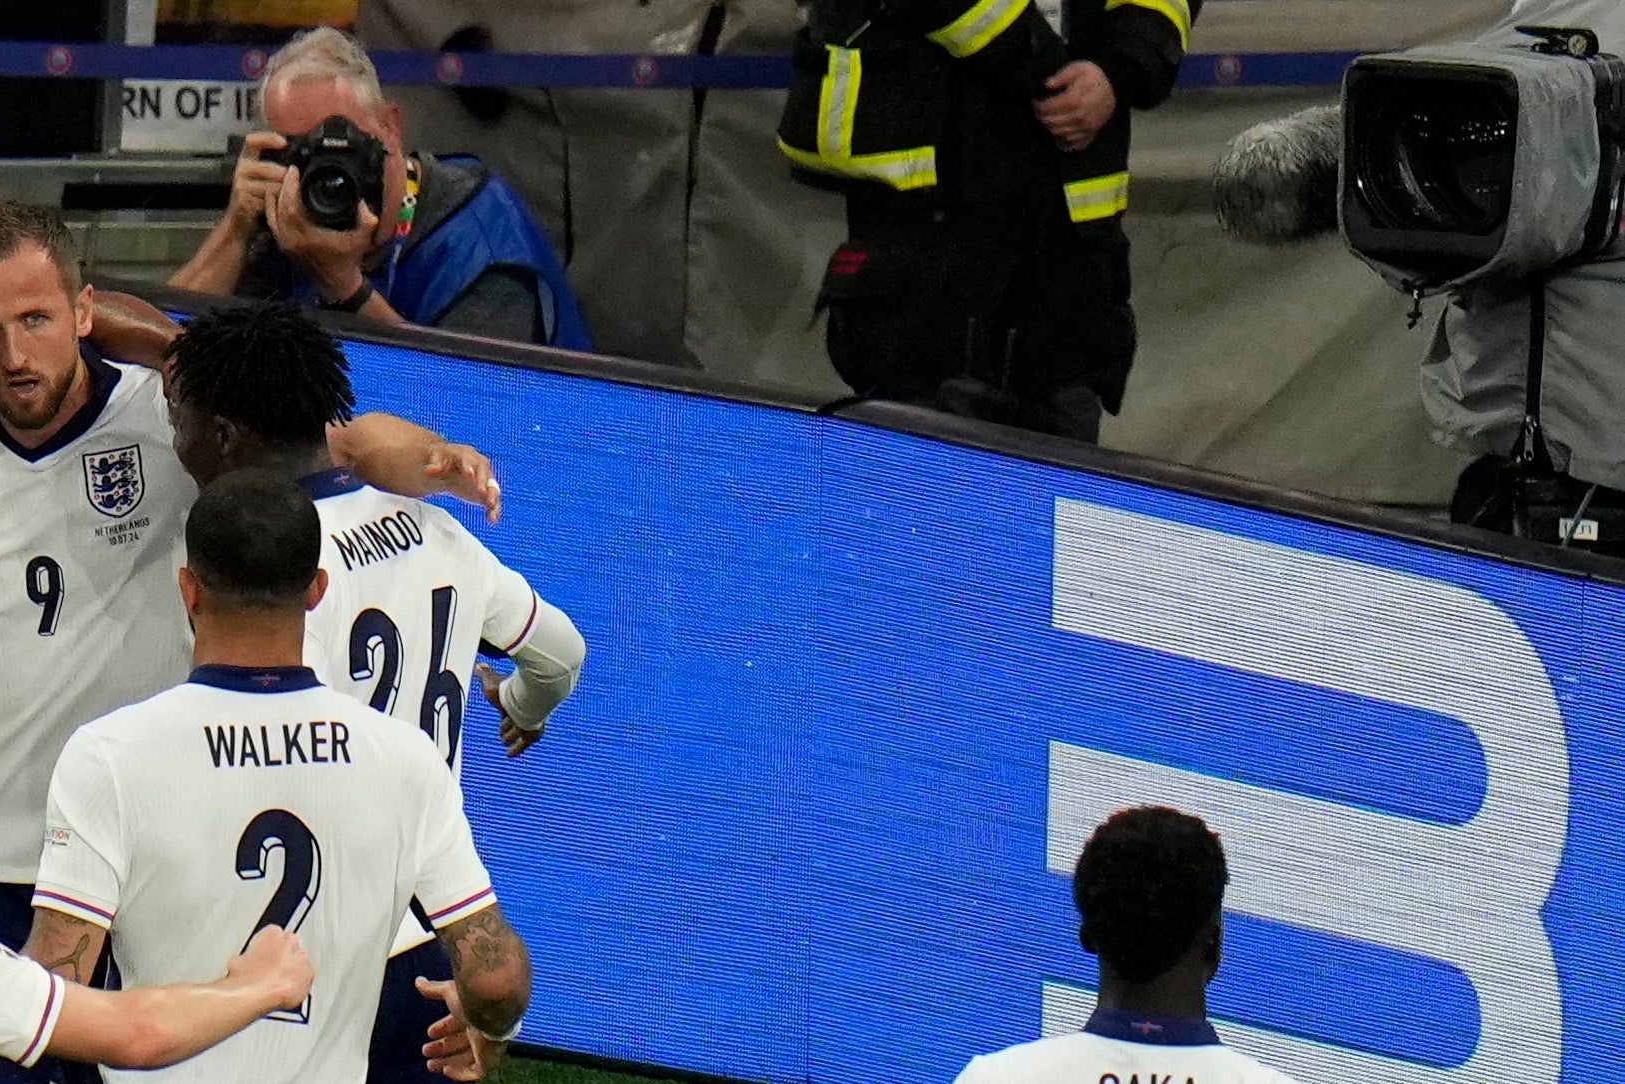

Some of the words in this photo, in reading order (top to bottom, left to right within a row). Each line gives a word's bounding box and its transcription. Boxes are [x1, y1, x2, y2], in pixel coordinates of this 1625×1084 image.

[175, 87, 223, 119] OF
[331, 510, 423, 572] MAINOO
[26, 555, 65, 636] 9
[349, 585, 466, 774] 26
[204, 720, 352, 768] WALKER
[234, 808, 322, 1024] 2
